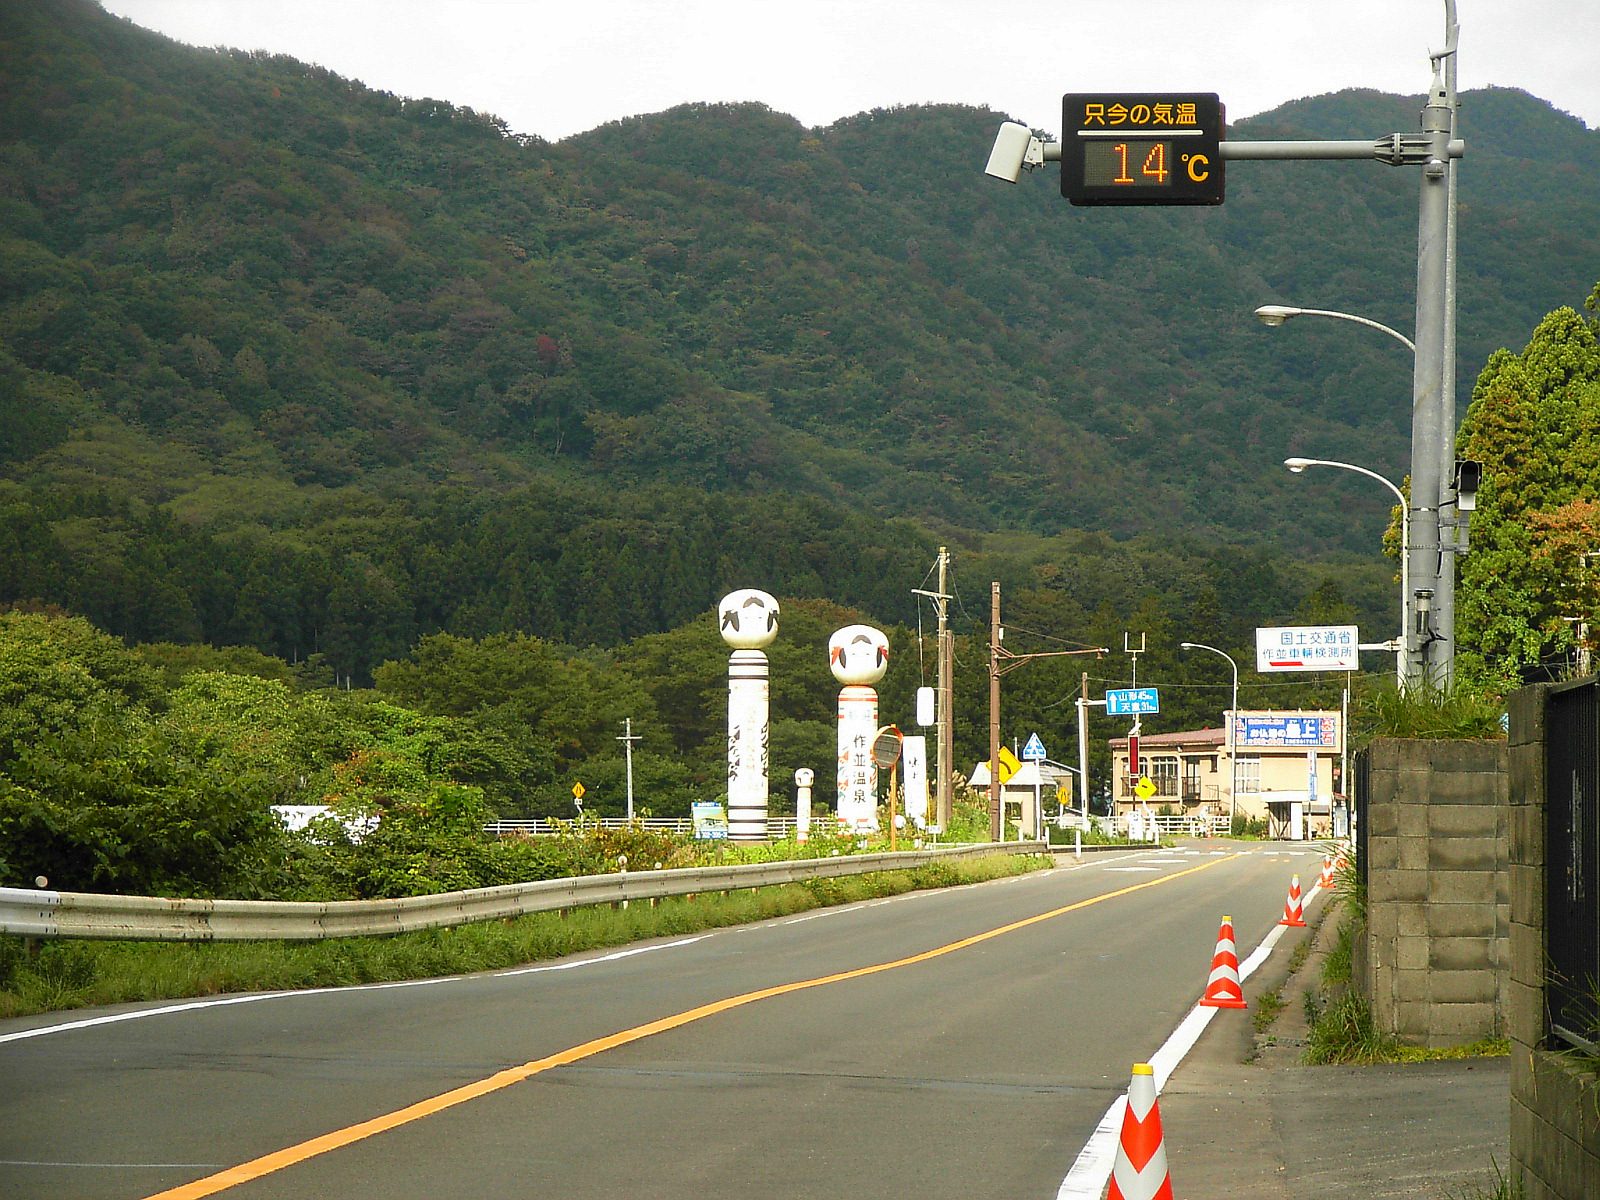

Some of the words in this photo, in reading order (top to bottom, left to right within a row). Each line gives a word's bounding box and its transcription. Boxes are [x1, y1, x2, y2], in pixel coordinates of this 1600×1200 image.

[1084, 102, 1197, 125] 只今の気温
[1113, 143, 1168, 184] 14
[1280, 630, 1351, 645] 国土交通省
[1118, 691, 1137, 701] 山形
[853, 733, 867, 804] 作並温泉
